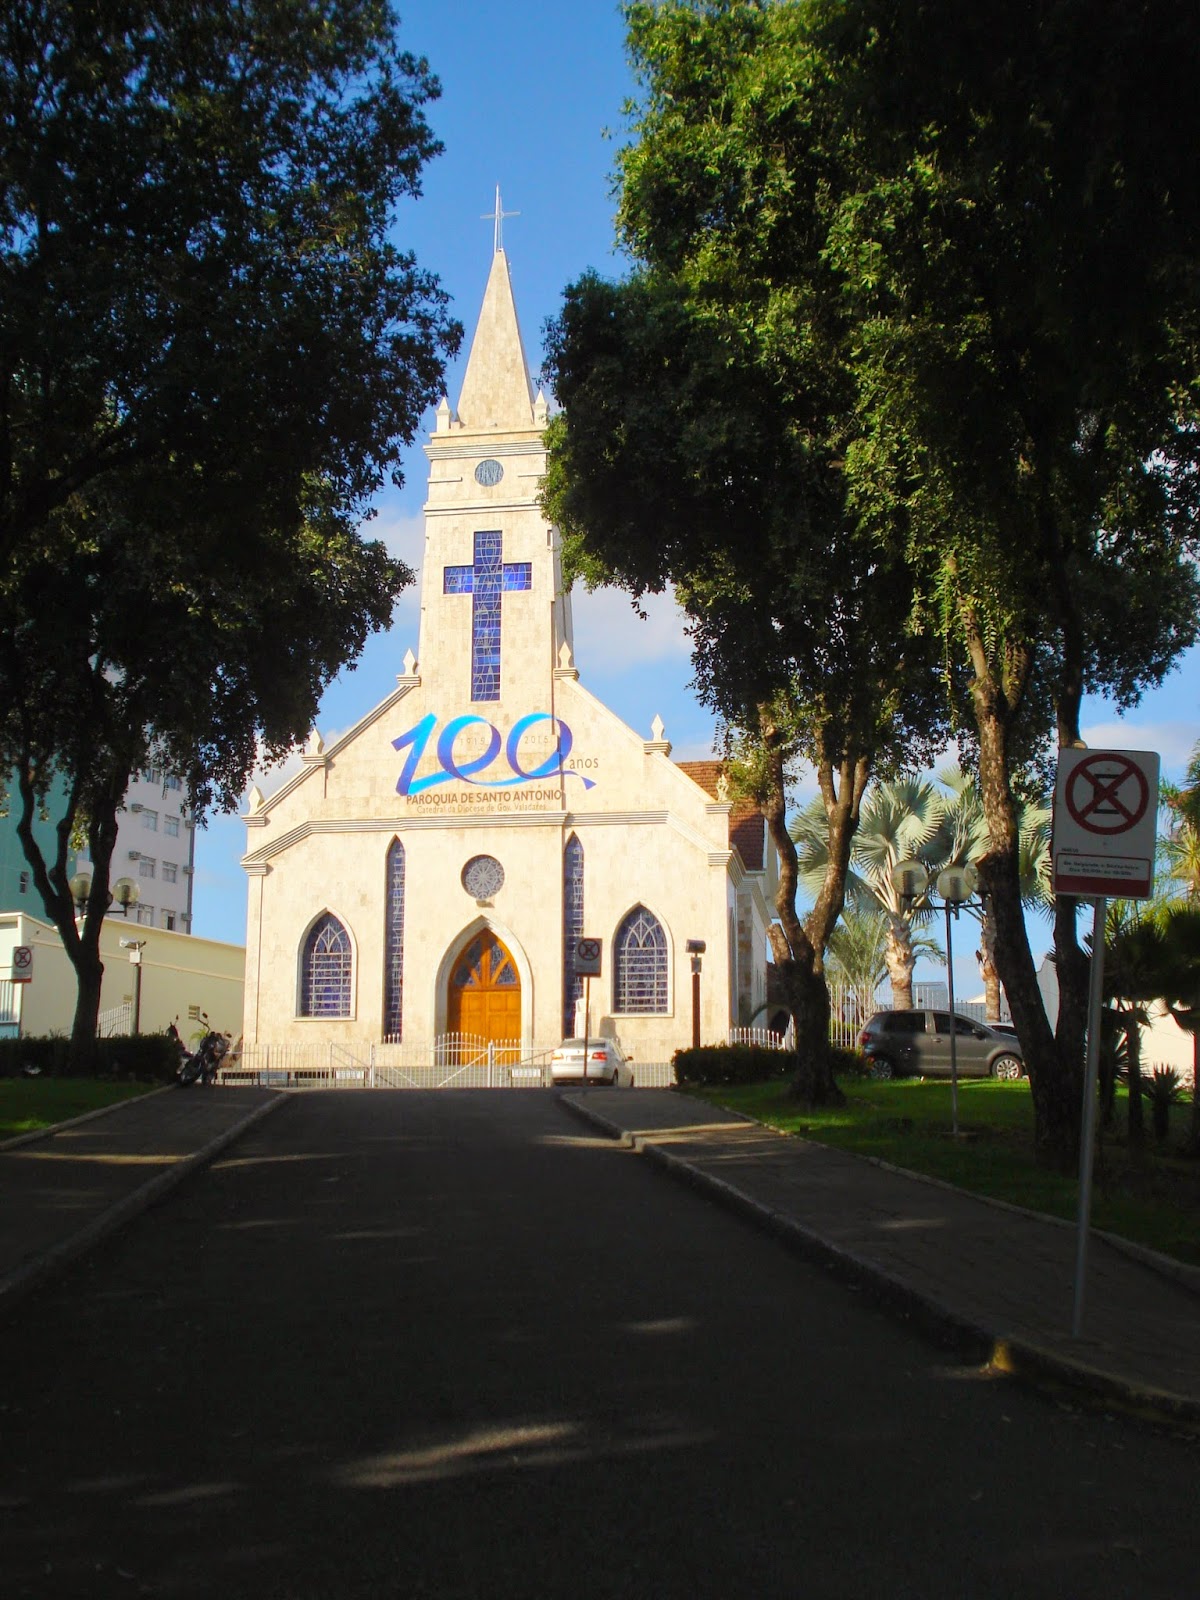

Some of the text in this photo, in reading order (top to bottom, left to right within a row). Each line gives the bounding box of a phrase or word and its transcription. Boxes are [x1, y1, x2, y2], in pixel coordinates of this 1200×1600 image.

[525, 735, 549, 744] 2015
[391, 711, 574, 796] 100
[569, 757, 599, 770] anos
[461, 792, 474, 803] DE
[476, 791, 511, 803] SANTO
[416, 805, 445, 814] Catedral
[448, 805, 456, 813] da
[458, 804, 485, 813] Diocese
[486, 804, 495, 812] de
[514, 802, 547, 811] Valadares
